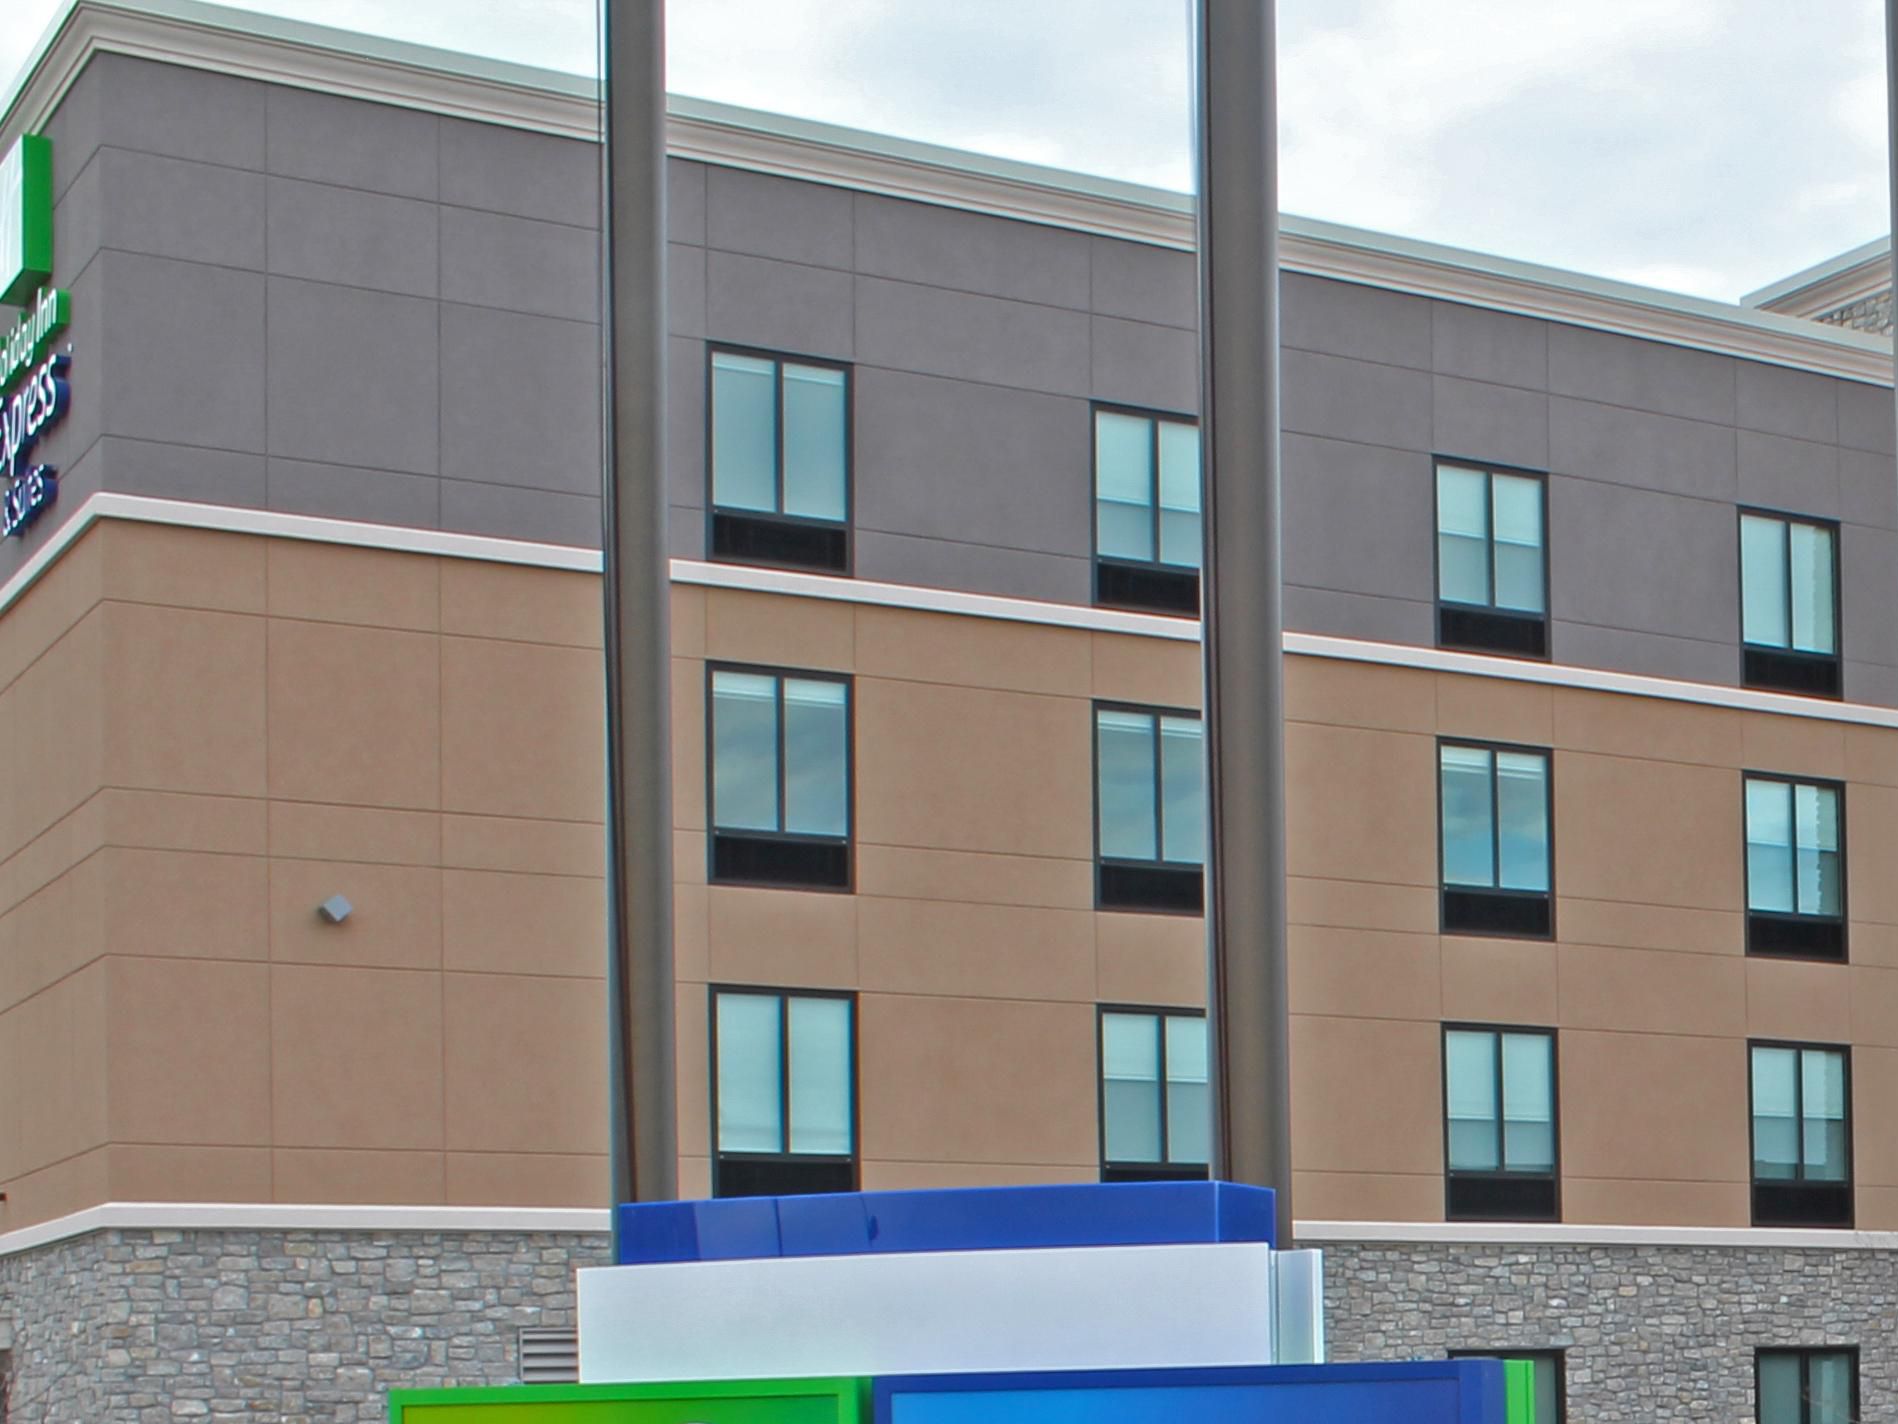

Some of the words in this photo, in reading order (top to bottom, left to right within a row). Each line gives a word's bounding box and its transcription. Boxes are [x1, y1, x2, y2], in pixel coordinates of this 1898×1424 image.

[0, 312, 36, 387] oliday
[36, 287, 58, 343] Inn
[0, 353, 57, 476] xpress
